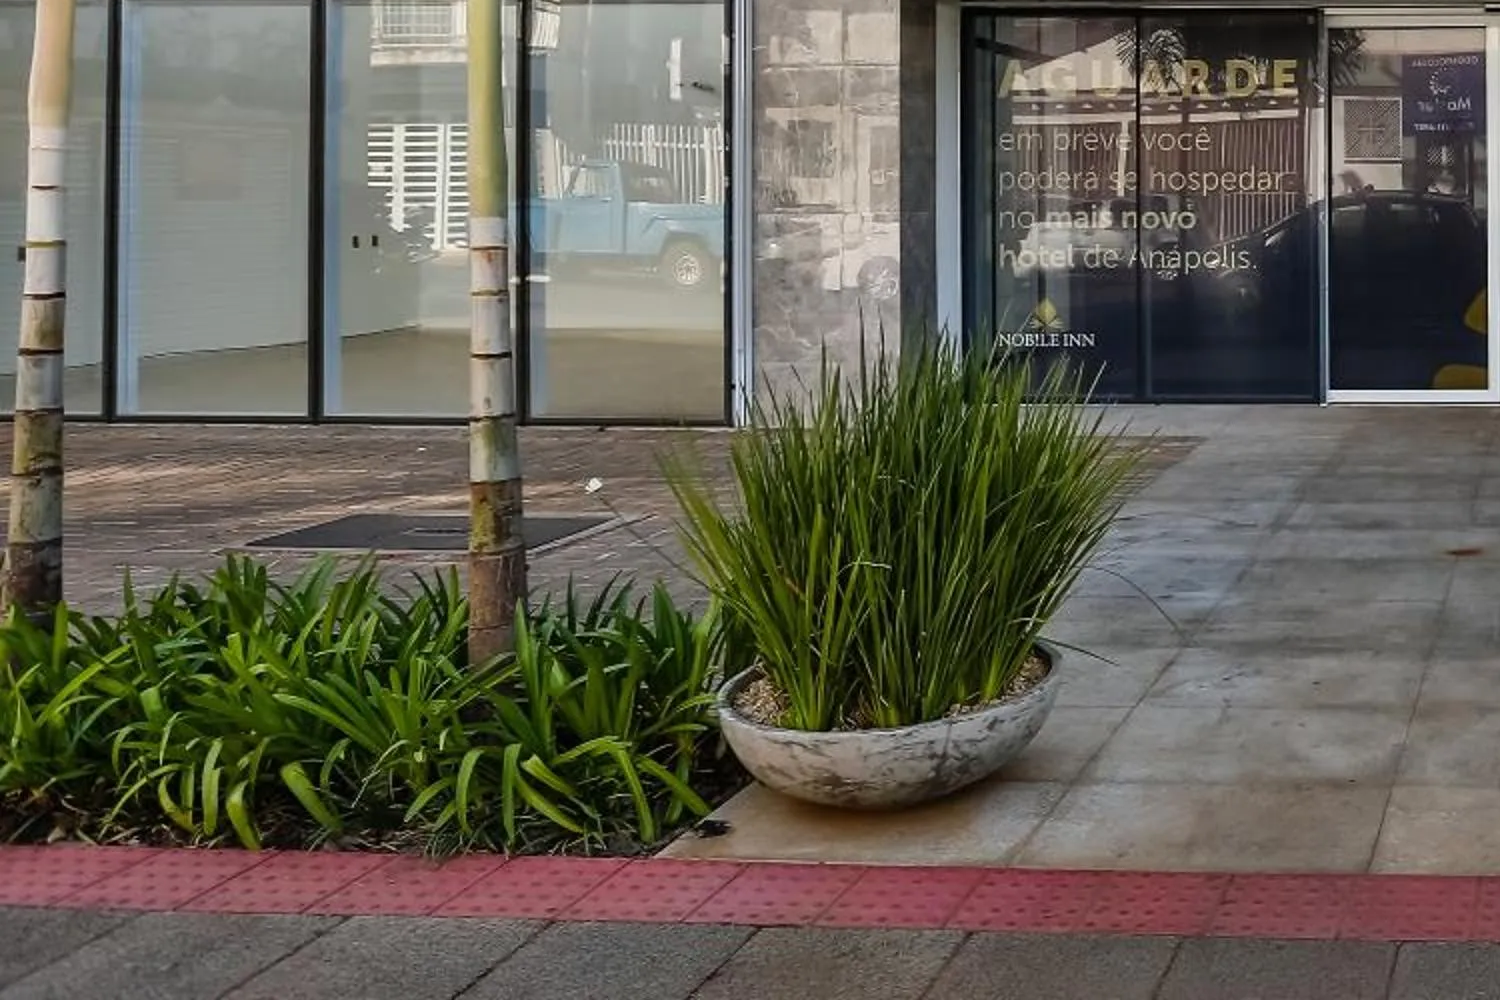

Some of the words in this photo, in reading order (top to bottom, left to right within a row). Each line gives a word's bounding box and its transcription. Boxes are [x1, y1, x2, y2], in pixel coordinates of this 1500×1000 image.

[998, 59, 1298, 98] AGUARDE
[999, 133, 1043, 151] em
[1054, 128, 1132, 151] breve
[1142, 127, 1212, 151] você
[999, 166, 1098, 195] poderá
[1109, 172, 1138, 190] se
[1150, 166, 1284, 196] hospedar
[999, 210, 1035, 229] no
[1046, 204, 1112, 229] mais
[1121, 209, 1198, 230] novo
[999, 244, 1075, 269] hotel
[1083, 244, 1118, 269] de
[1128, 244, 1258, 273] Anápolis.
[998, 332, 1061, 348] NOBILE
[1063, 332, 1096, 348] INN
